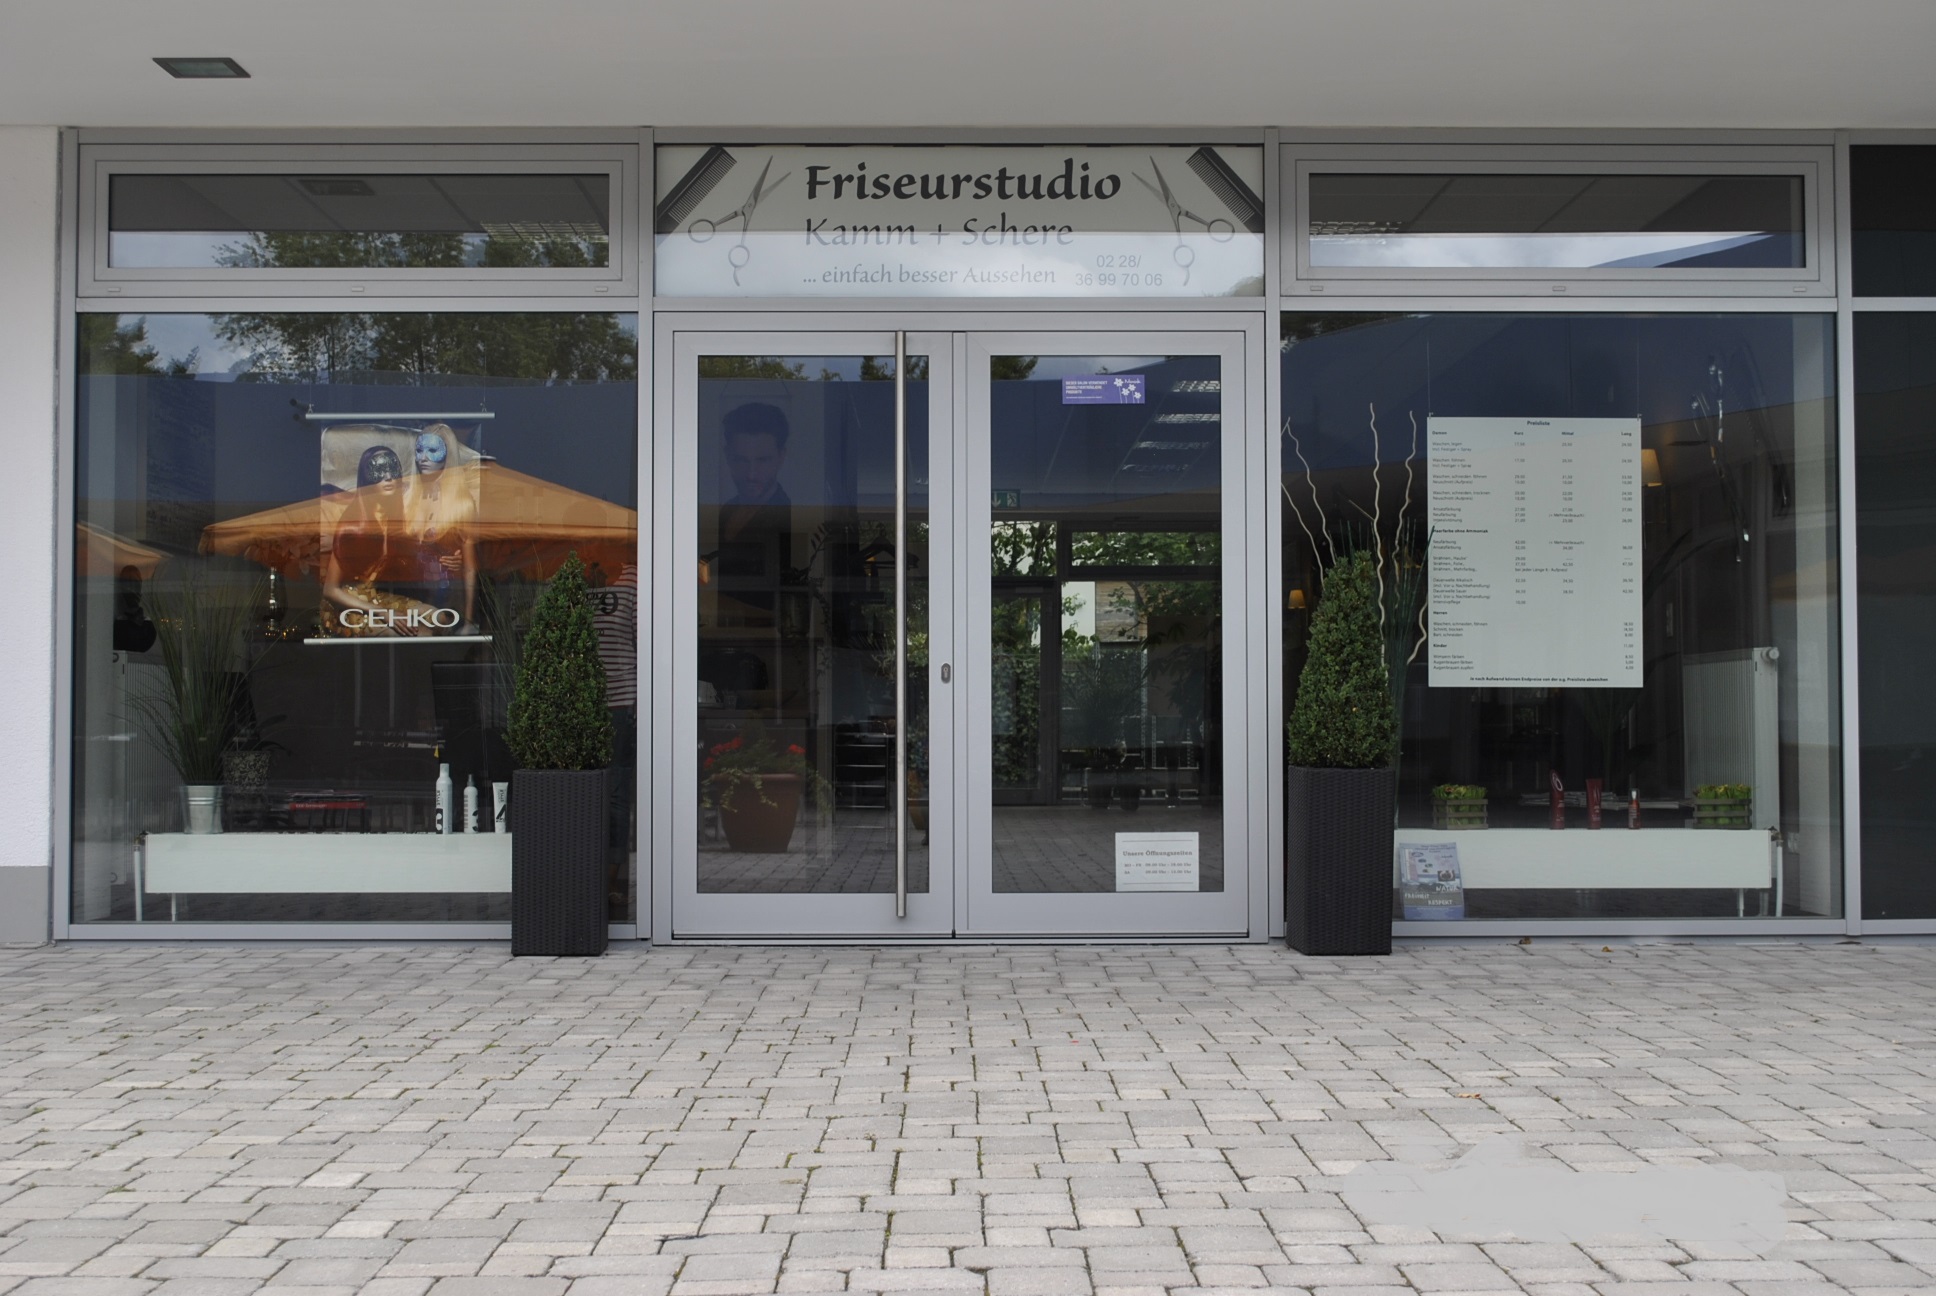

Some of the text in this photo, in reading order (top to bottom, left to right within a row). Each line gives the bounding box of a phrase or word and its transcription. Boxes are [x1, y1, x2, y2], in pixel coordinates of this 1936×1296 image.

[805, 158, 1122, 201] Friseurstudio
[805, 212, 1074, 246] Kamm + Schere
[1096, 255, 1142, 269] 02 28/
[822, 263, 893, 283] einfach
[899, 263, 959, 283] besser
[962, 263, 1056, 284] Aussehen
[1075, 273, 1163, 286] 36 99 70 06
